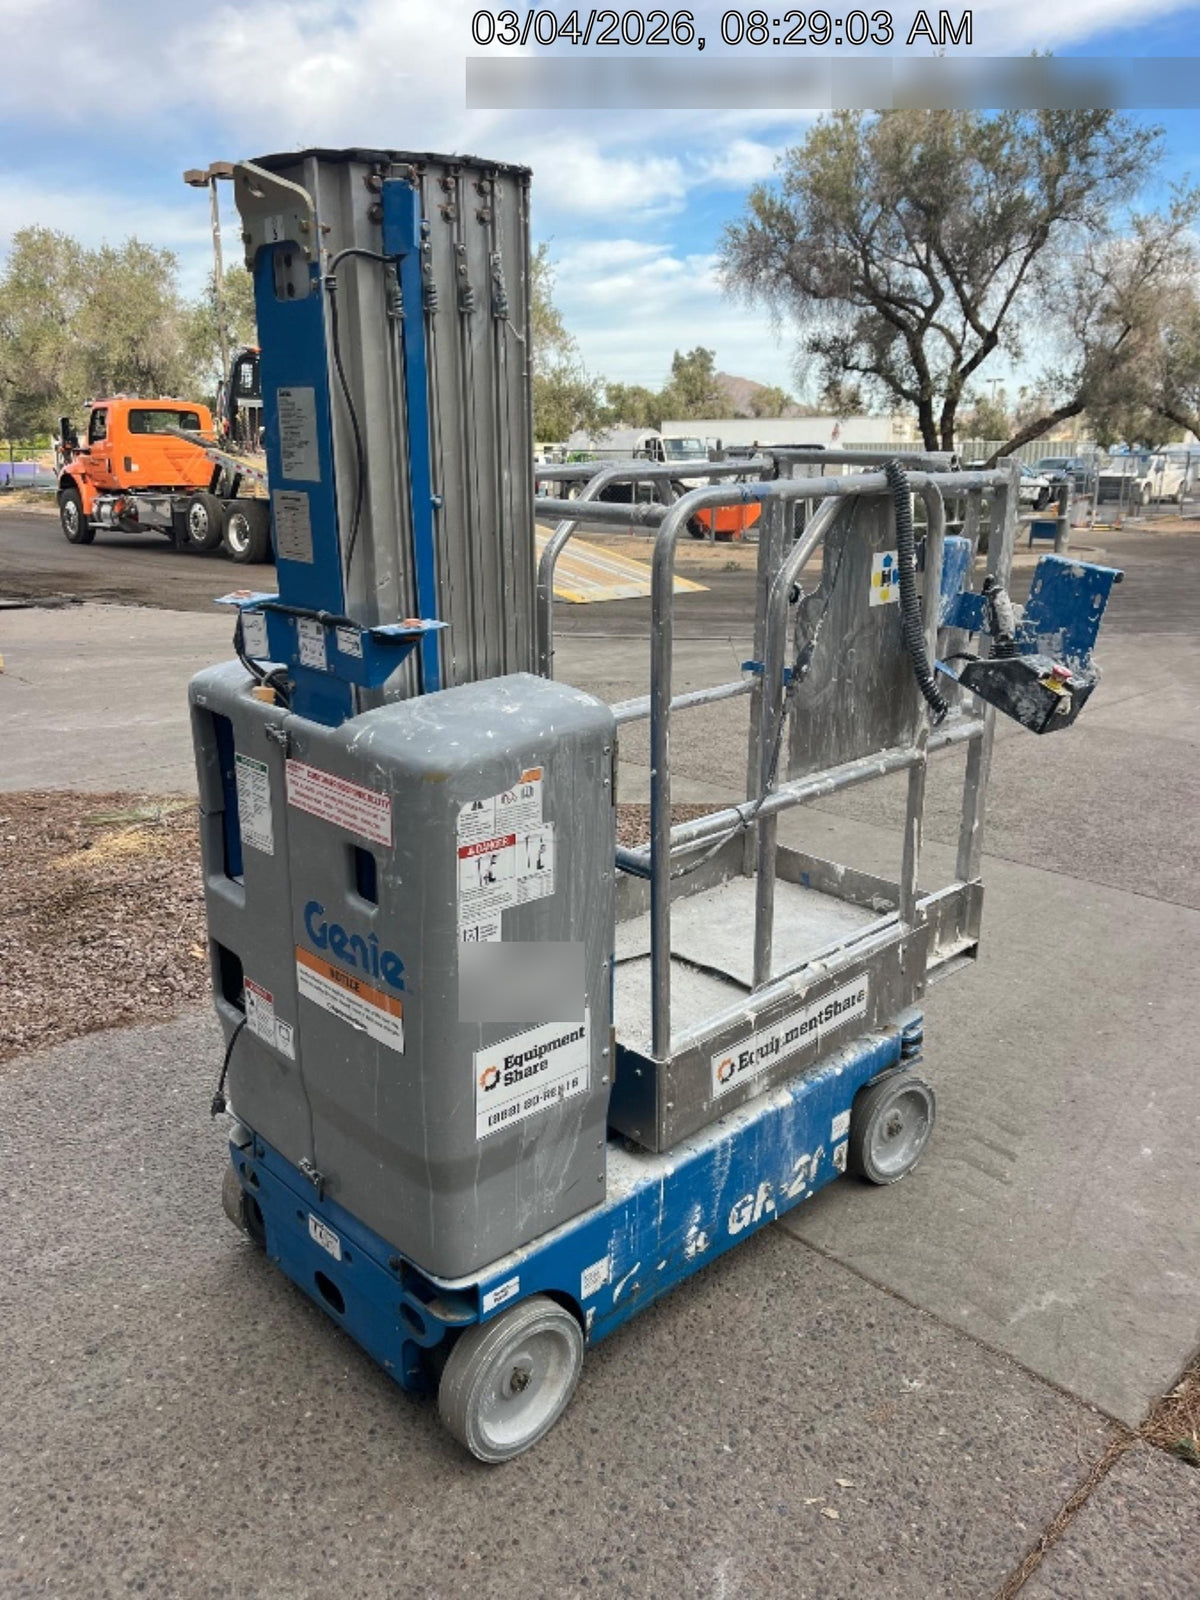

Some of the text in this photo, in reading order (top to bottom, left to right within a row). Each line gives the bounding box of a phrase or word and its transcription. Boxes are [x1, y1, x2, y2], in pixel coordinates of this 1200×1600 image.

[304, 900, 406, 992] Genie
[503, 1026, 586, 1071] Equipment
[503, 1059, 549, 1087] Share
